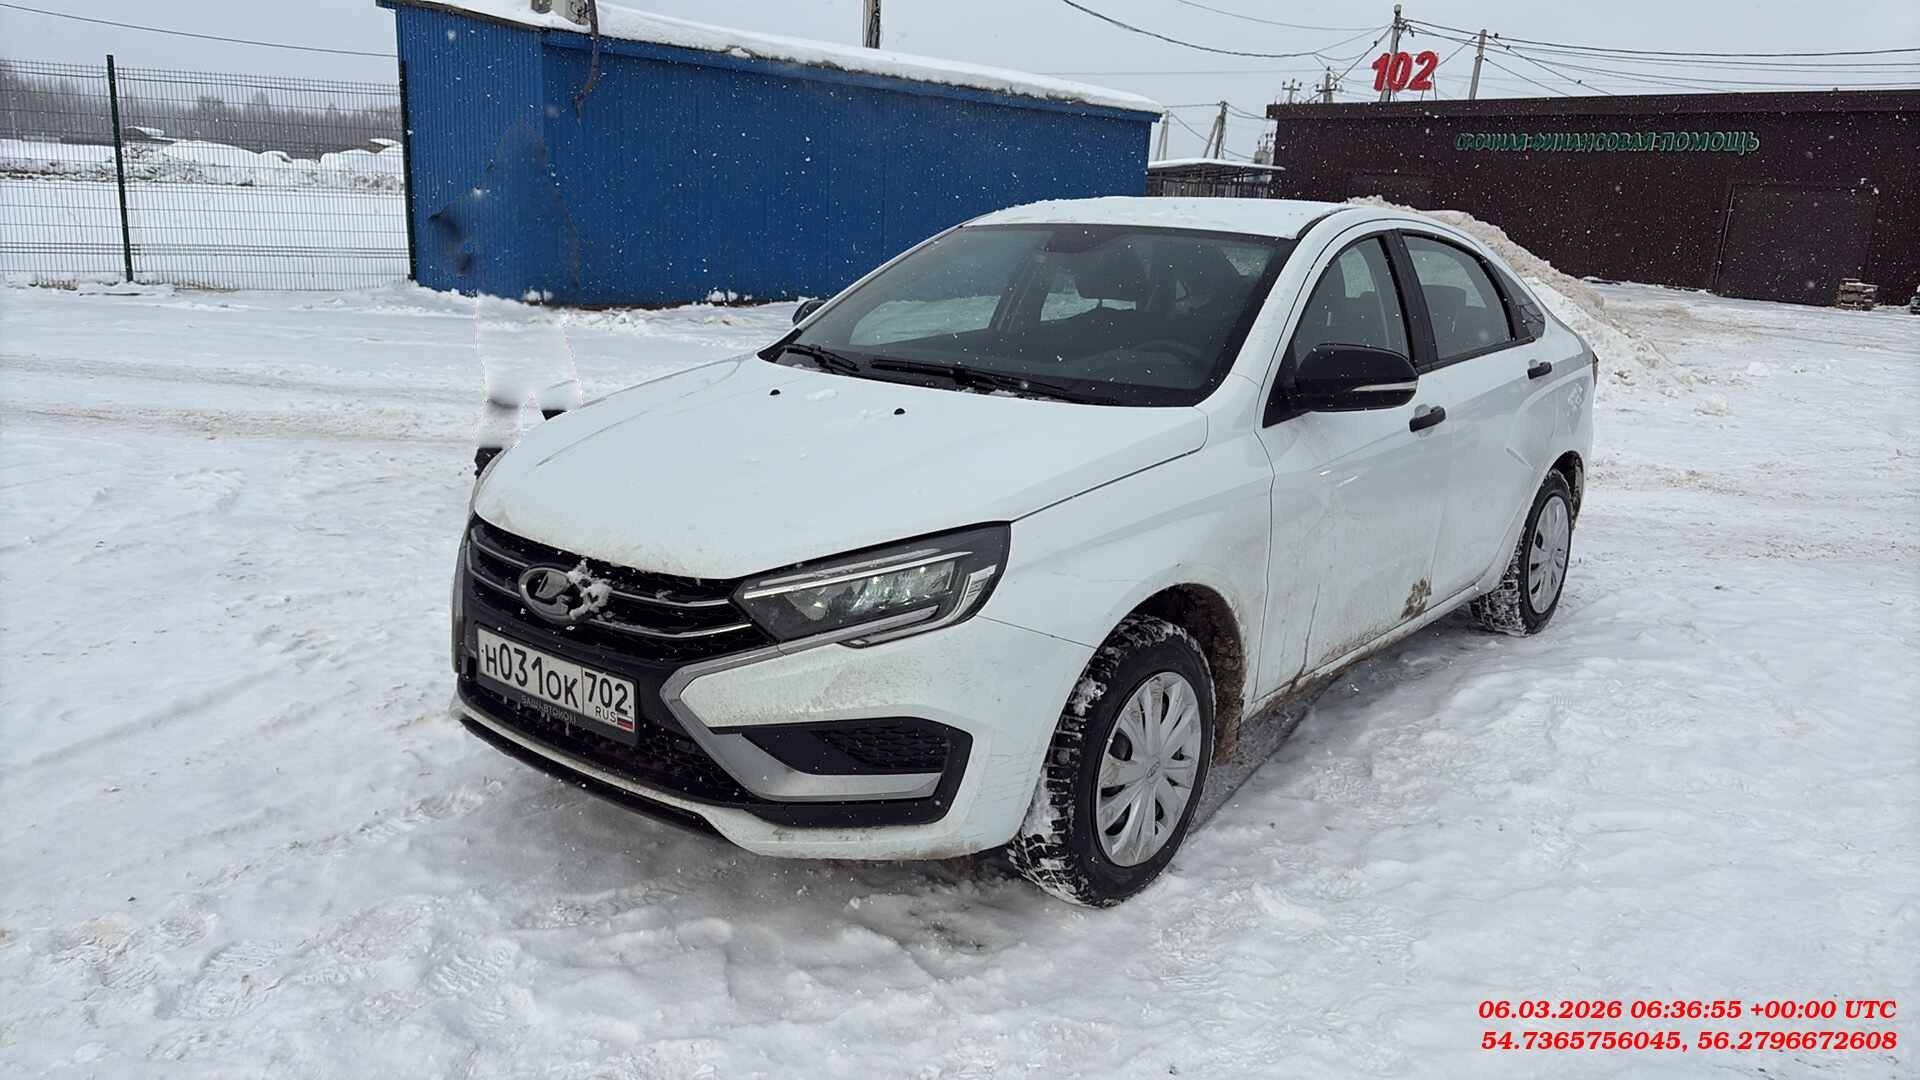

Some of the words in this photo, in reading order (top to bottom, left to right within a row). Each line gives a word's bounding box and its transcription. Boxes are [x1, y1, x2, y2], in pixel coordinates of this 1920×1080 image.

[1372, 51, 1438, 91] 102
[1456, 133, 1529, 151] СРОЧНАЯ
[1532, 132, 1656, 151] ФИНАНСОВАЯ
[1660, 131, 1760, 155] ПОМОЩЬ
[584, 671, 629, 716] 702
[595, 706, 617, 723] RUS
